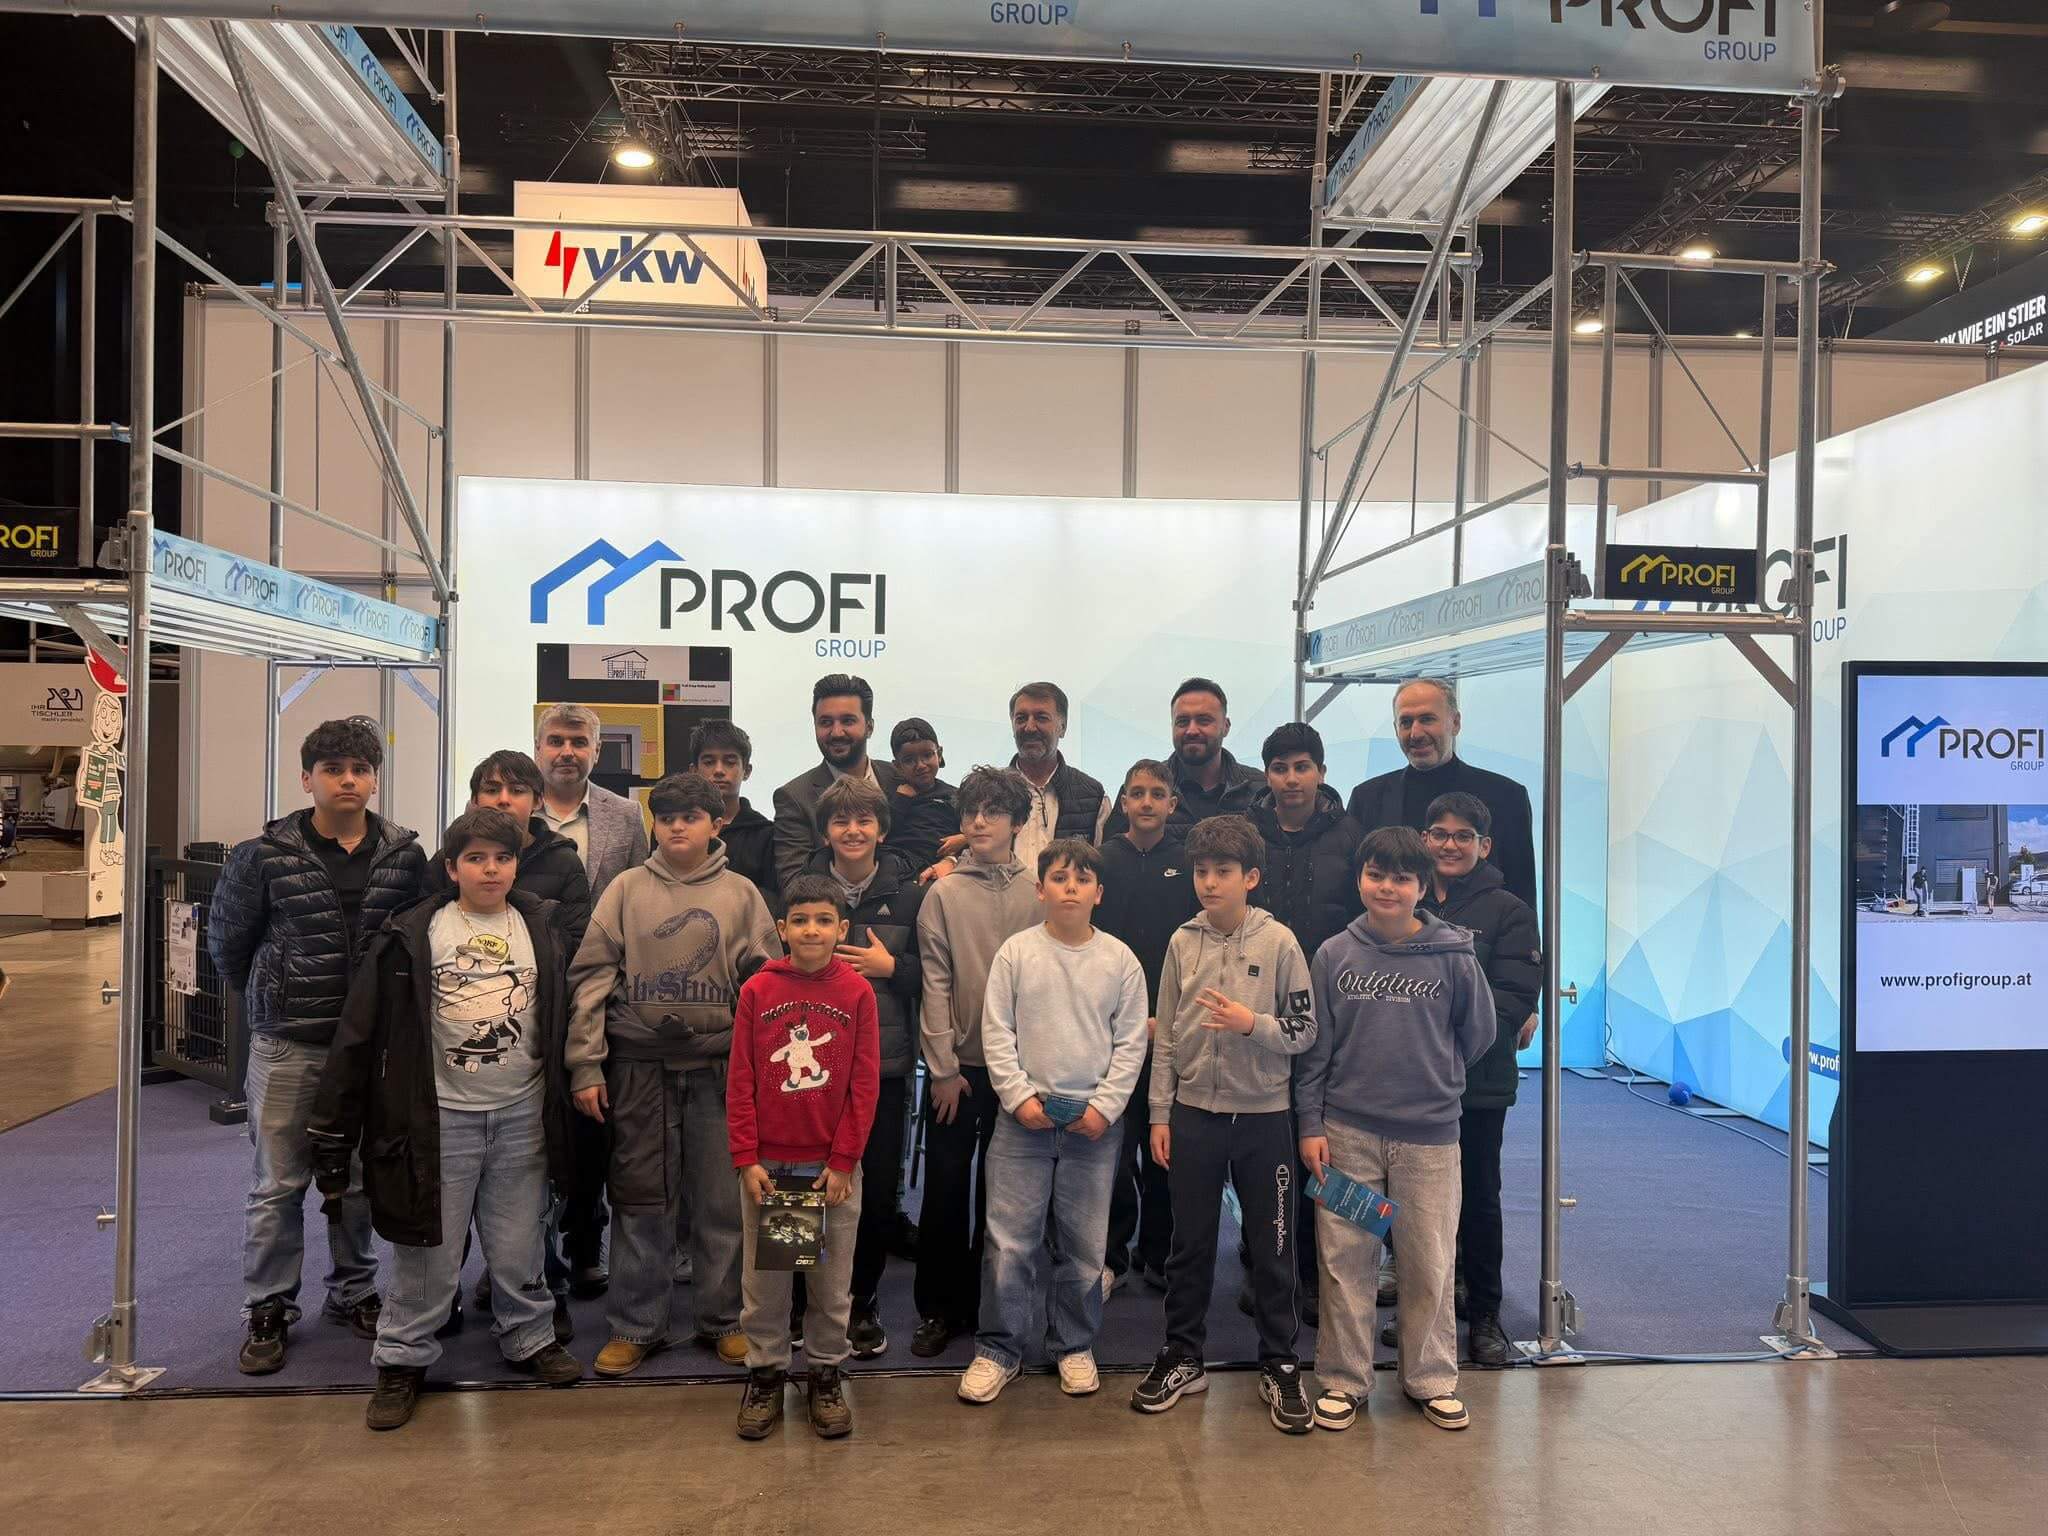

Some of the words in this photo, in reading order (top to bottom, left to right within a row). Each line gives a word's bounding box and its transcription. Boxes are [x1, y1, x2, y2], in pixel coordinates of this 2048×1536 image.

[990, 1, 1069, 25] GROUP
[1704, 40, 1777, 62] GROUP
[583, 235, 706, 285] vkw
[1958, 321, 1984, 345] WIE
[1984, 311, 2006, 338] EIN
[2007, 294, 2047, 329] STIER
[2007, 322, 2044, 346] SOLAR
[30, 549, 59, 558] GROUP
[164, 550, 207, 585] PROFI
[1661, 562, 1736, 587] PROFI
[244, 574, 279, 603] PROFI
[660, 567, 887, 635] PROFI
[1711, 586, 1736, 595] GROUP
[312, 592, 341, 621] PROFI
[1452, 594, 1482, 621] PROFI
[815, 639, 887, 659] GROUP
[1939, 728, 2045, 760] PROFI
[2010, 760, 2045, 771] GROUP
[1880, 972, 2032, 990] www.profigroup.at
